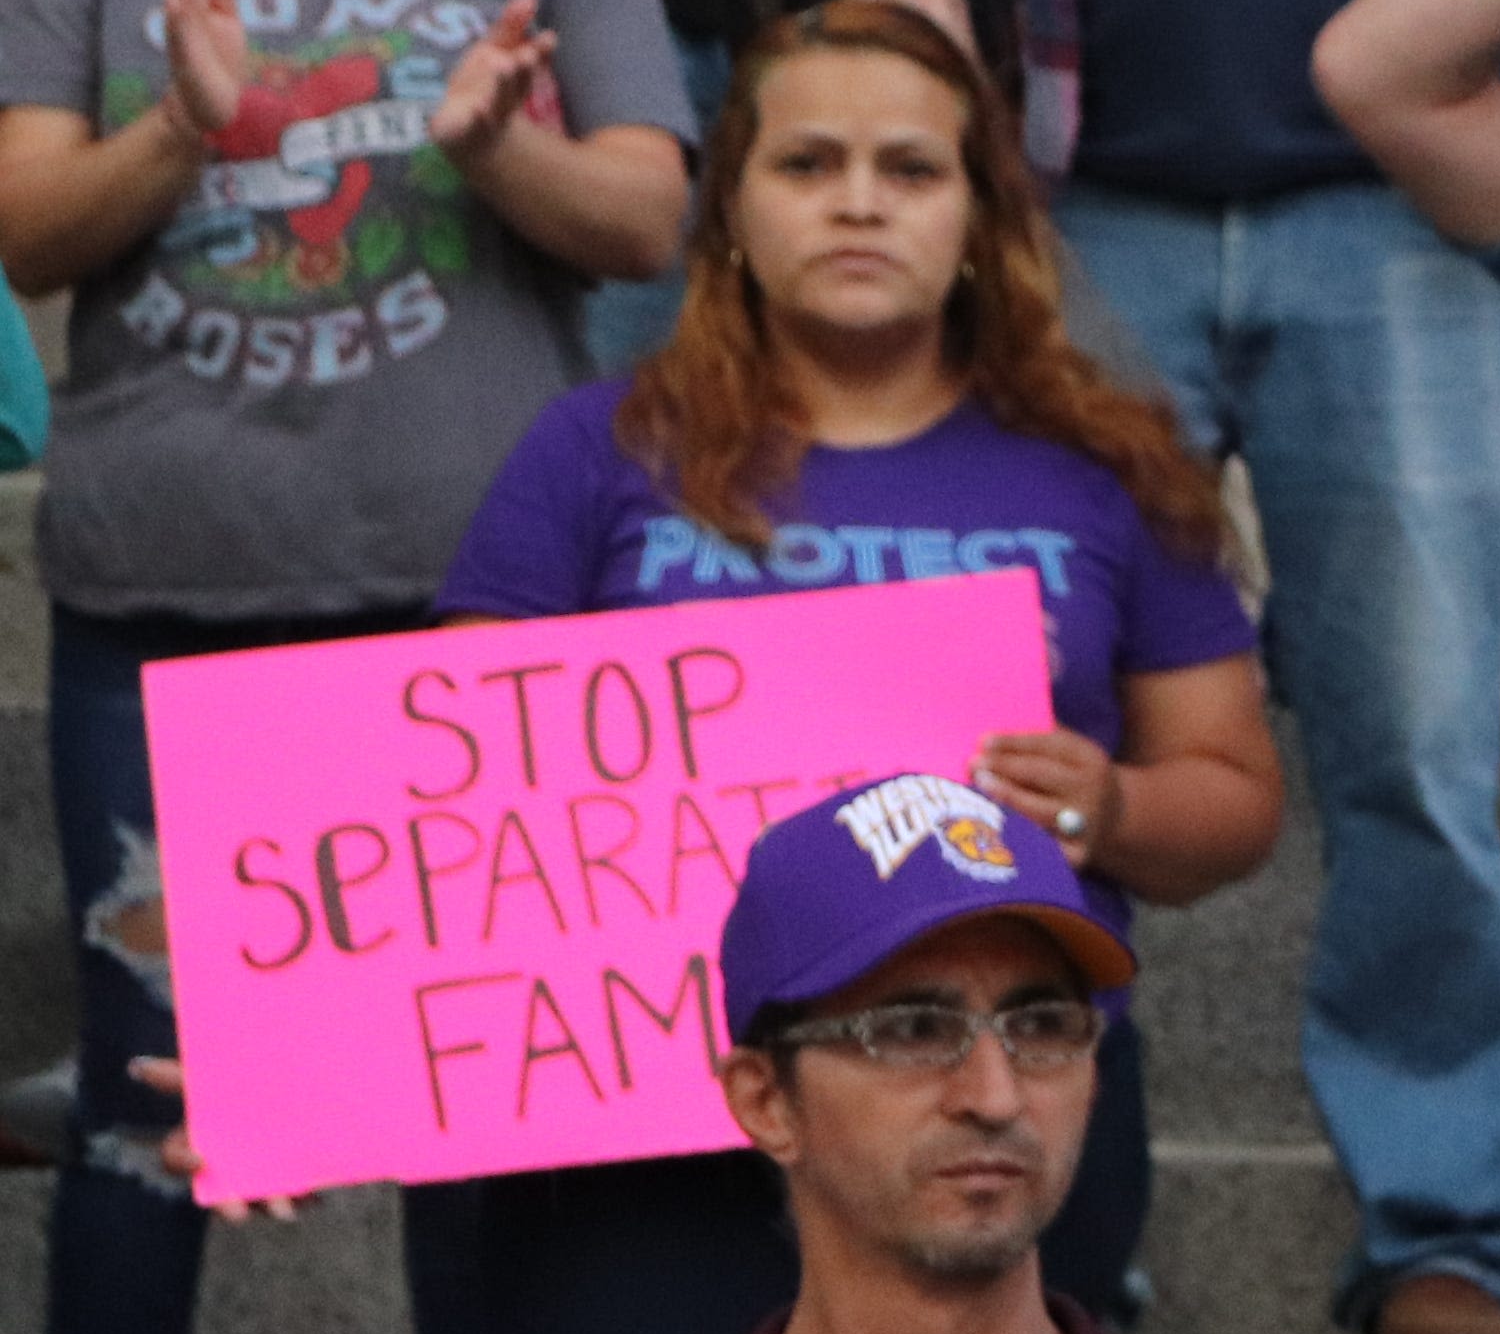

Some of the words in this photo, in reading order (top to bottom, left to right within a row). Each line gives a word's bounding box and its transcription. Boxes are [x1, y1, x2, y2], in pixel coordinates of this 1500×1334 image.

[121, 270, 447, 389] ROSES
[636, 517, 1078, 595] PROTECT
[402, 647, 746, 804] STOP
